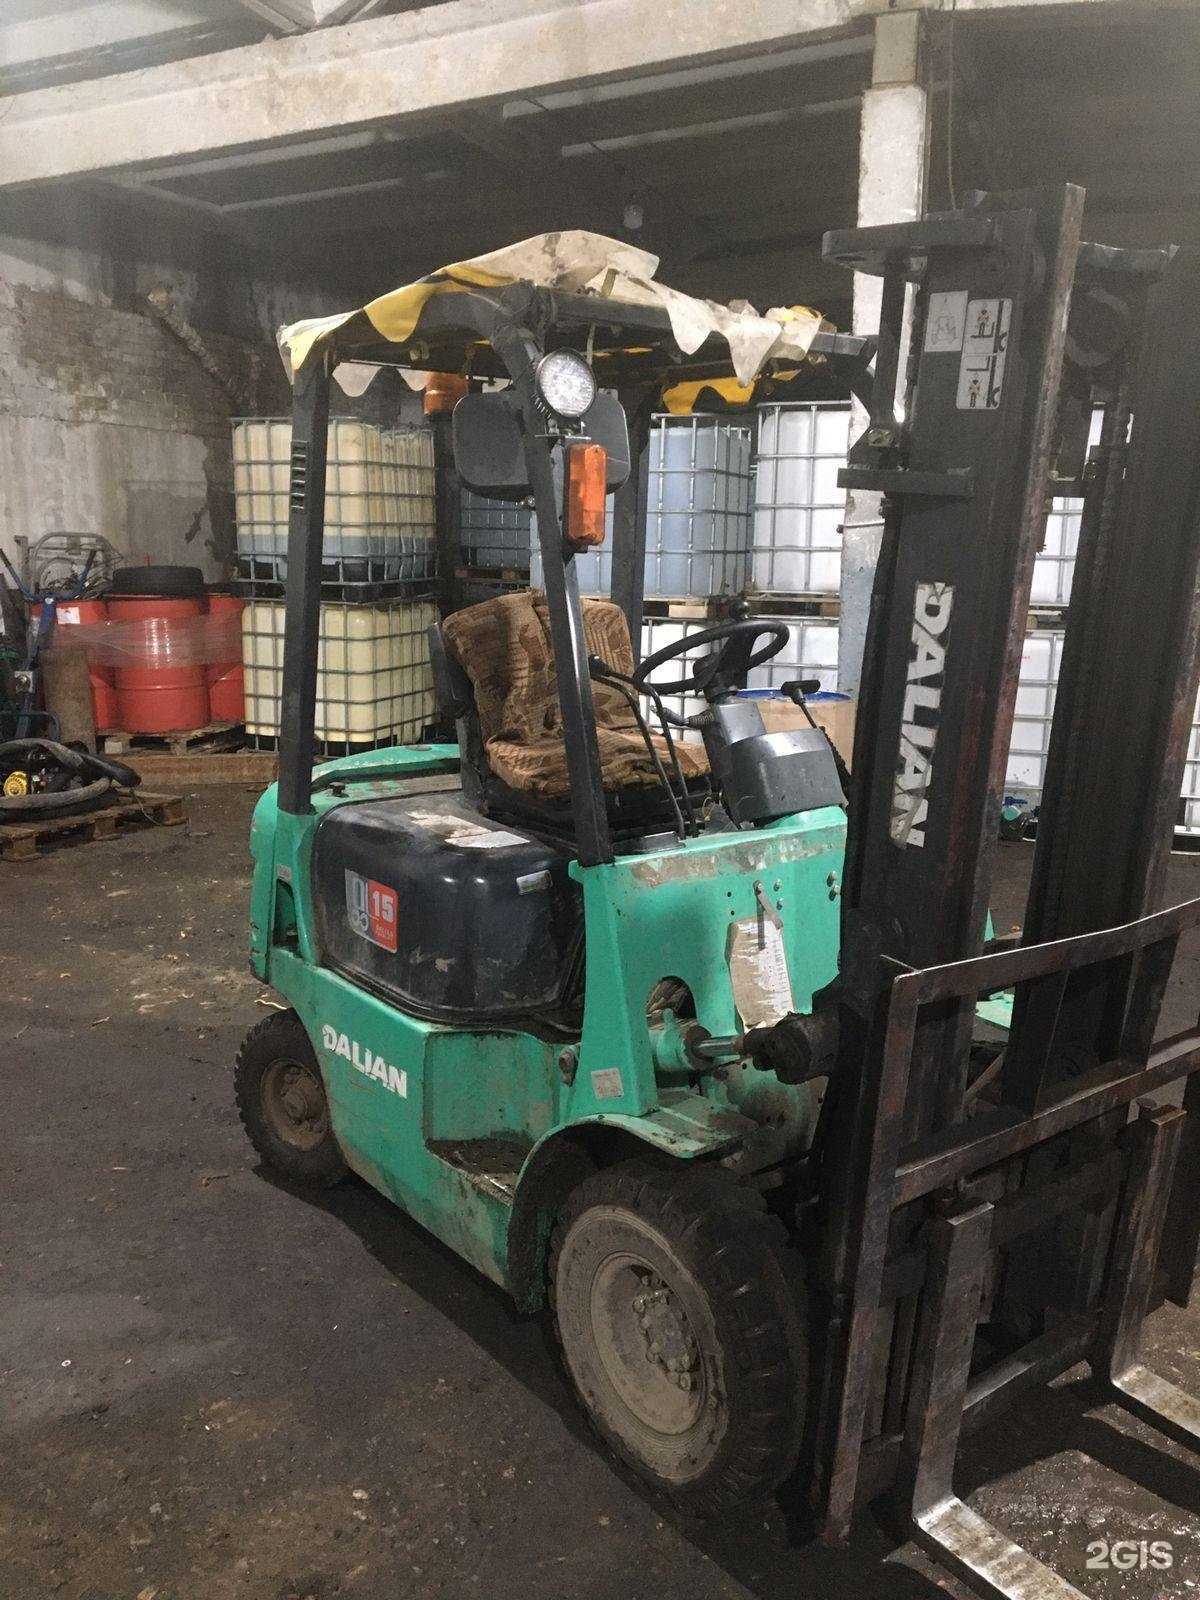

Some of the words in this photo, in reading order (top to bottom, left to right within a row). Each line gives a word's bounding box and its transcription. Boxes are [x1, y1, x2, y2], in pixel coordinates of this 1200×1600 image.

[890, 582, 953, 848] DALIAN
[372, 890, 394, 923] 15
[322, 1024, 407, 1099] DALIAN
